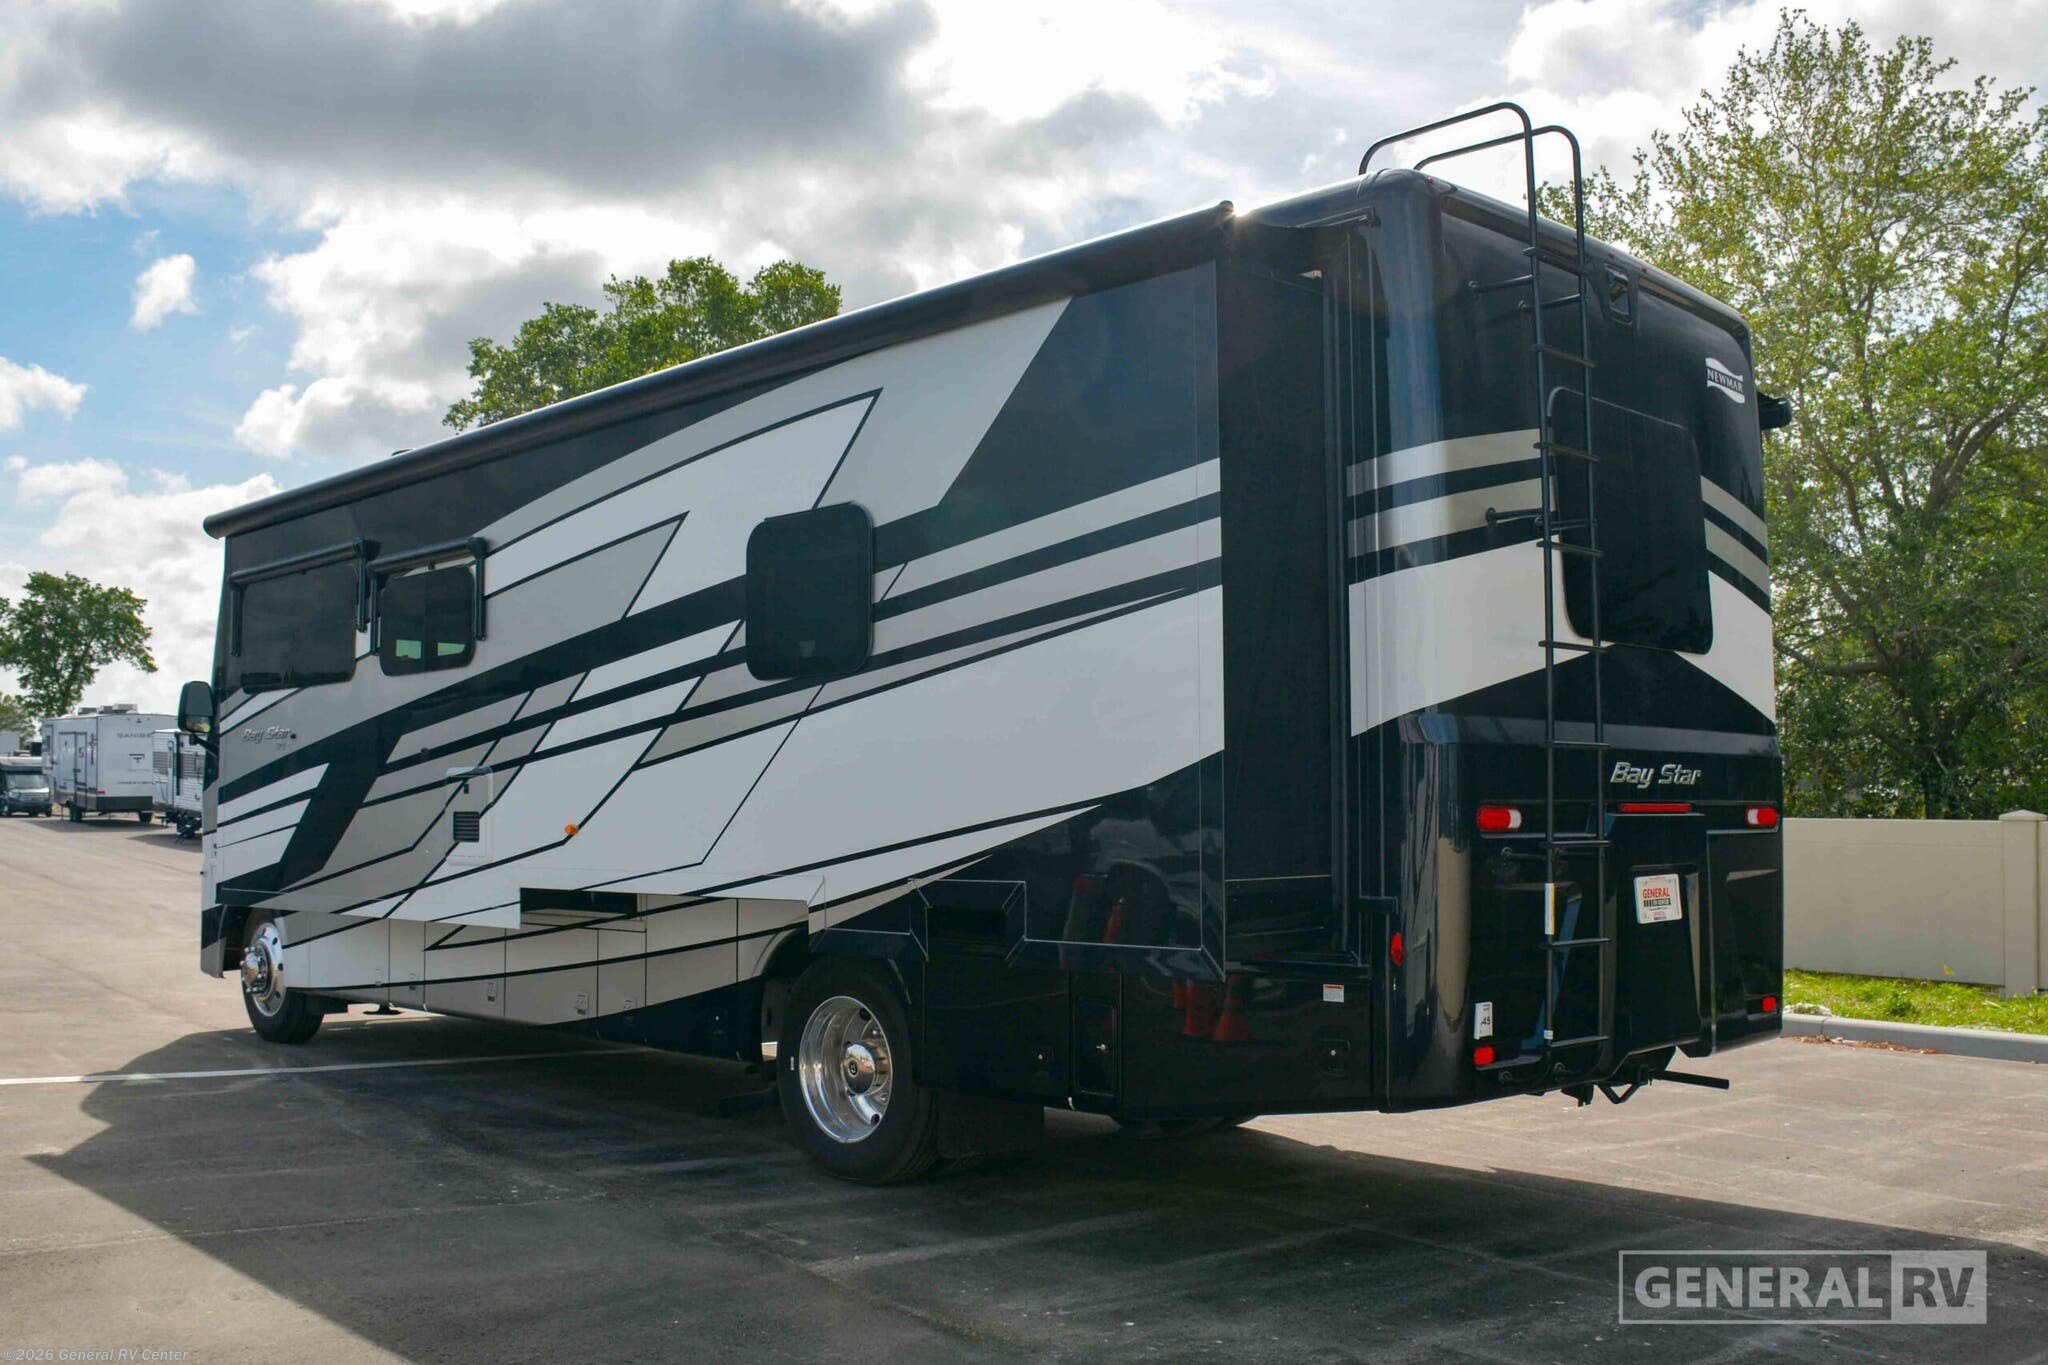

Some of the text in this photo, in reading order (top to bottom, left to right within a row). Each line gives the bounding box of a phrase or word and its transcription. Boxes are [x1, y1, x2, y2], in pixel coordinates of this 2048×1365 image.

[1707, 368, 1743, 393] NEWMAR
[1610, 761, 1703, 789] Bay Star
[1643, 887, 1670, 899] GENERAL
